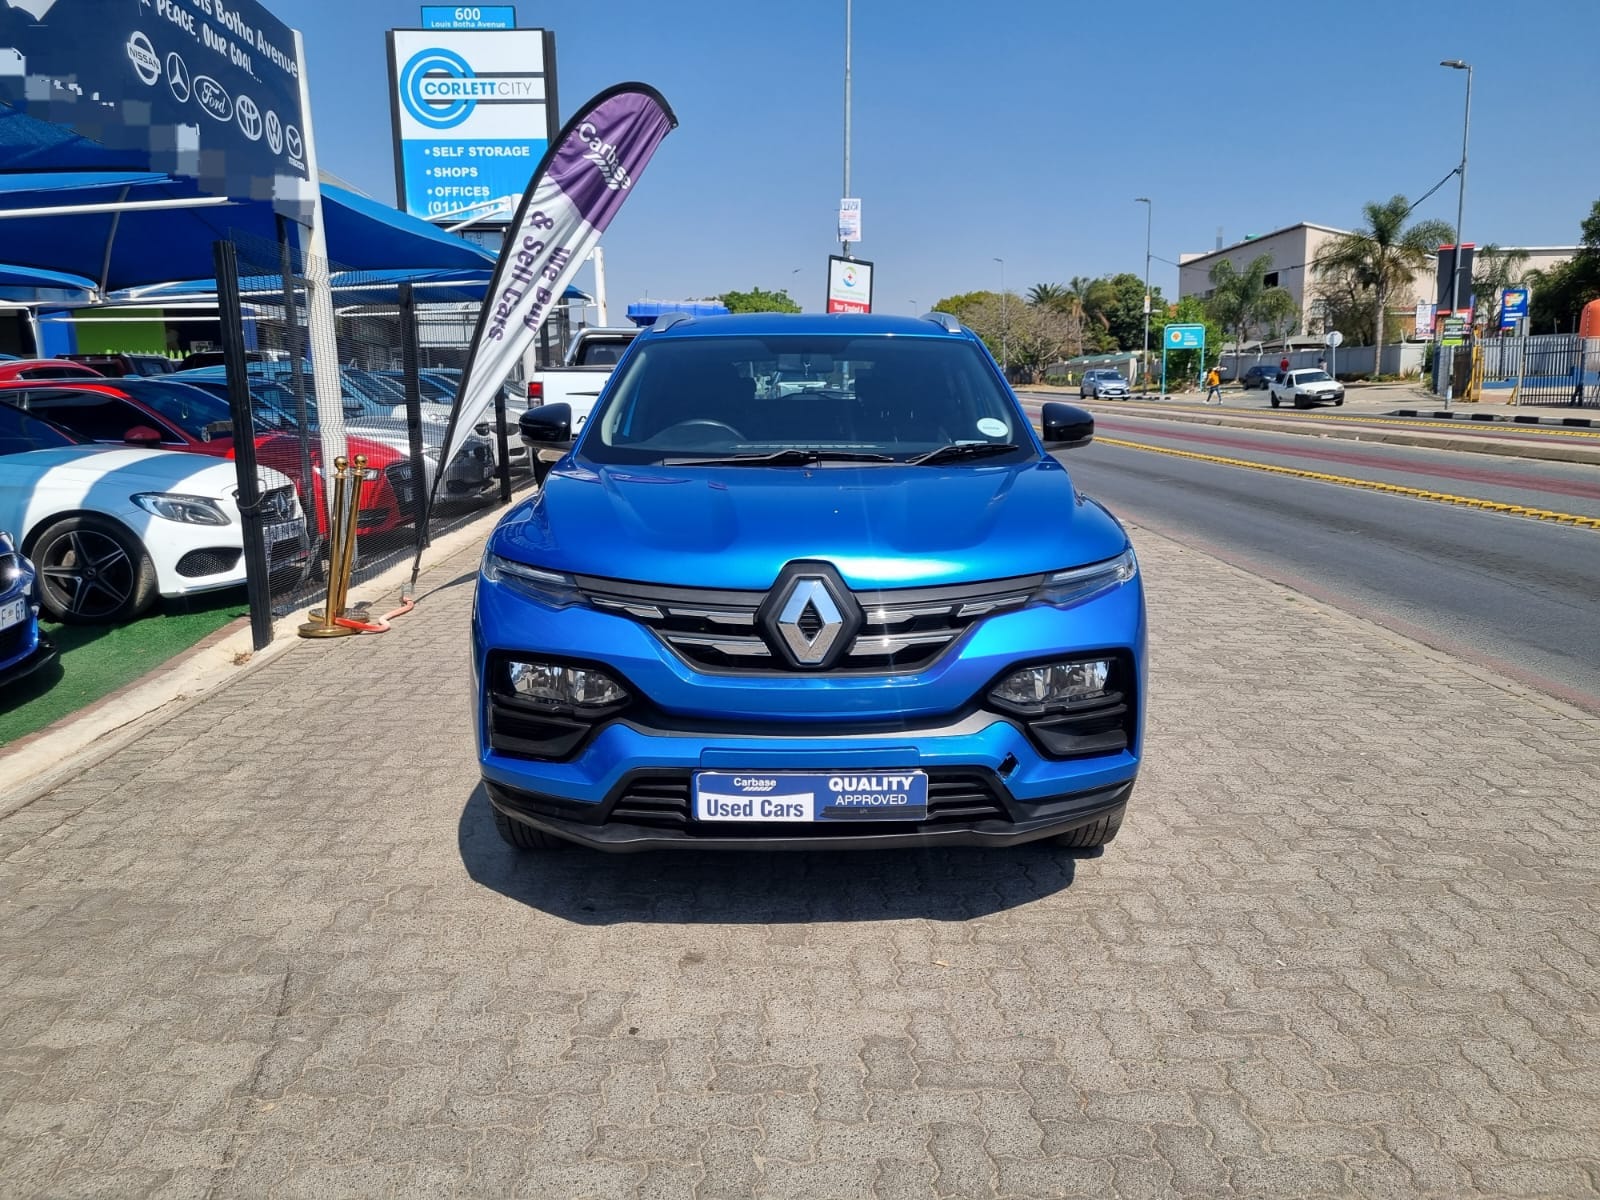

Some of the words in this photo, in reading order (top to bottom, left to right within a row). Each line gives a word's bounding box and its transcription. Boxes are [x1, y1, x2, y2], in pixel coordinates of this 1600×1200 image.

[431, 20, 451, 28] Louis
[453, 20, 475, 28] Botha
[477, 20, 506, 28] Avenue
[455, 7, 481, 21] 600
[202, 23, 228, 57] OUR
[214, 0, 255, 46] Botha
[257, 29, 298, 79] Avenue
[129, 50, 160, 71] NISSAN
[201, 81, 227, 114] Ford
[432, 146, 464, 157] SELF
[468, 146, 531, 157] STORAGE
[433, 167, 478, 177] SHOPS
[435, 186, 490, 197] OFFICES
[531, 210, 554, 231] &
[517, 235, 545, 285] Sell
[541, 247, 571, 282] We
[488, 287, 522, 341] Cars
[523, 286, 553, 332] Buy
[733, 777, 777, 787] Carbase
[828, 776, 914, 792] QUALITY
[706, 798, 753, 817] Used
[760, 799, 804, 817] Cars
[835, 794, 908, 806] APPROVED
